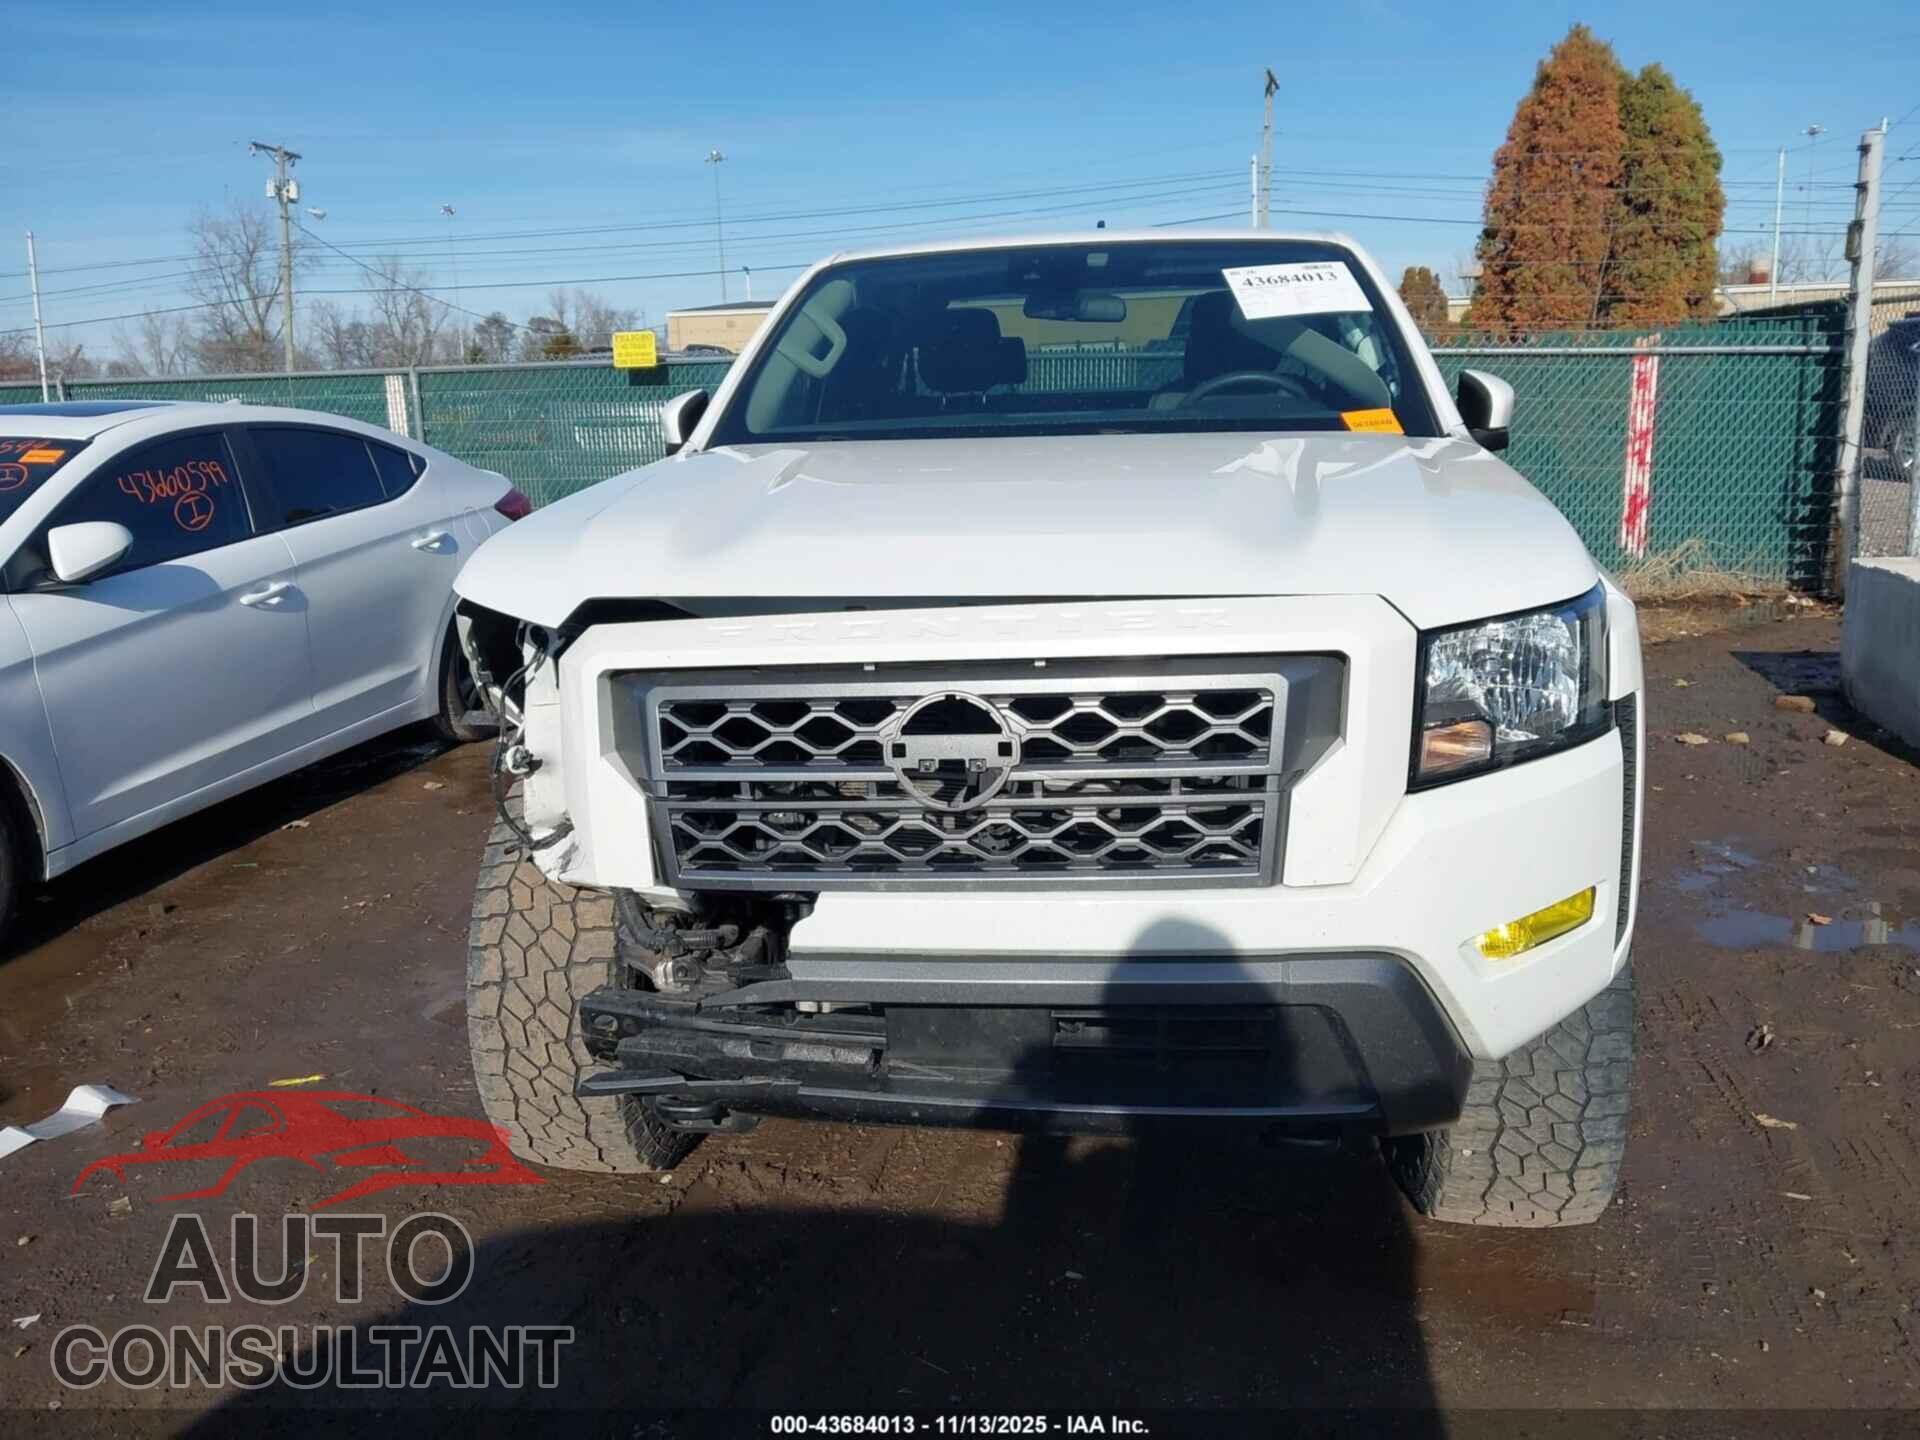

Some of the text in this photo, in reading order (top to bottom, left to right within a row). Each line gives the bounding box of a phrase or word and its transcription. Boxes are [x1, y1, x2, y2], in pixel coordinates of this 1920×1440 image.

[1242, 271, 1338, 287] 43684013
[117, 461, 228, 503] 43660599
[704, 608, 1233, 645] FRONTIER
